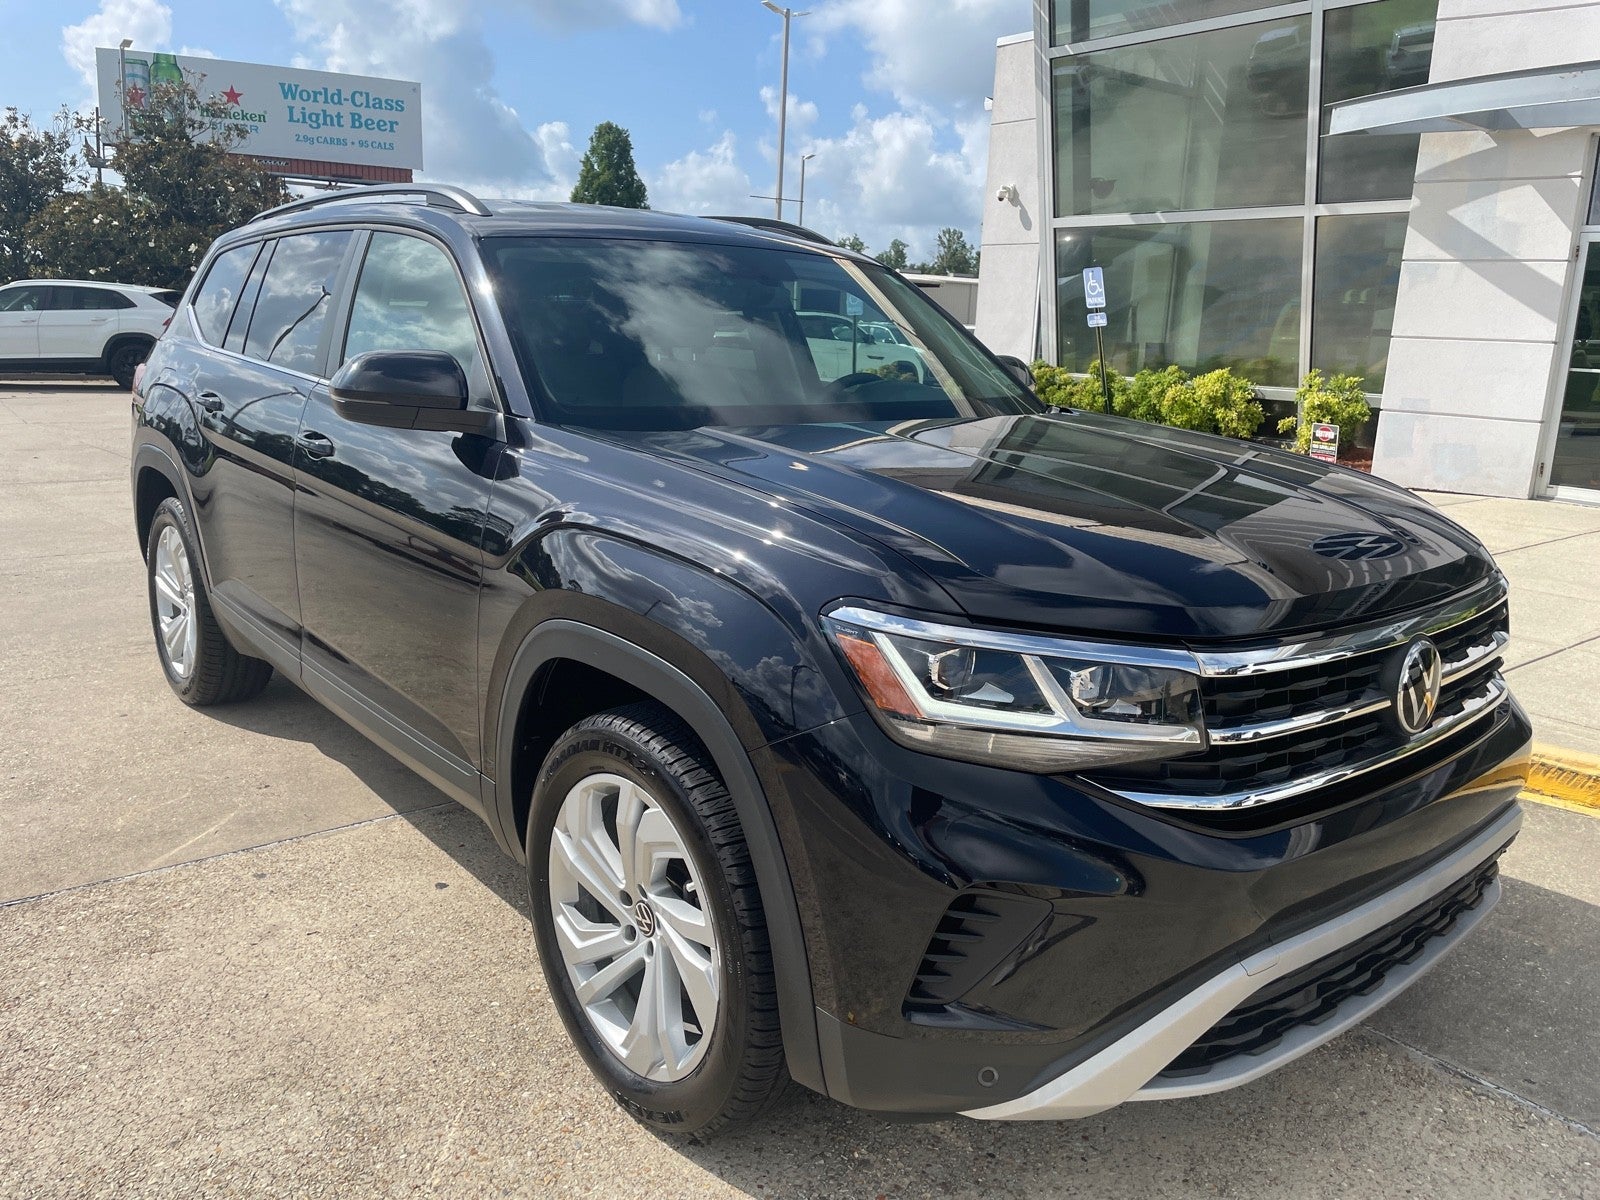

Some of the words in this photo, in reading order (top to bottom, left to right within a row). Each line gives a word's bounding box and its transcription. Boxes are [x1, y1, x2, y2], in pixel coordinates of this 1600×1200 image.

[279, 82, 405, 112] World-Class
[199, 105, 267, 123] Hneken
[287, 105, 344, 129] Light
[349, 111, 399, 133] Beer
[211, 121, 259, 134] SIR
[295, 133, 315, 145] 2.9g
[316, 135, 348, 147] CARBS
[358, 139, 369, 148] 95
[371, 140, 395, 150] CALS
